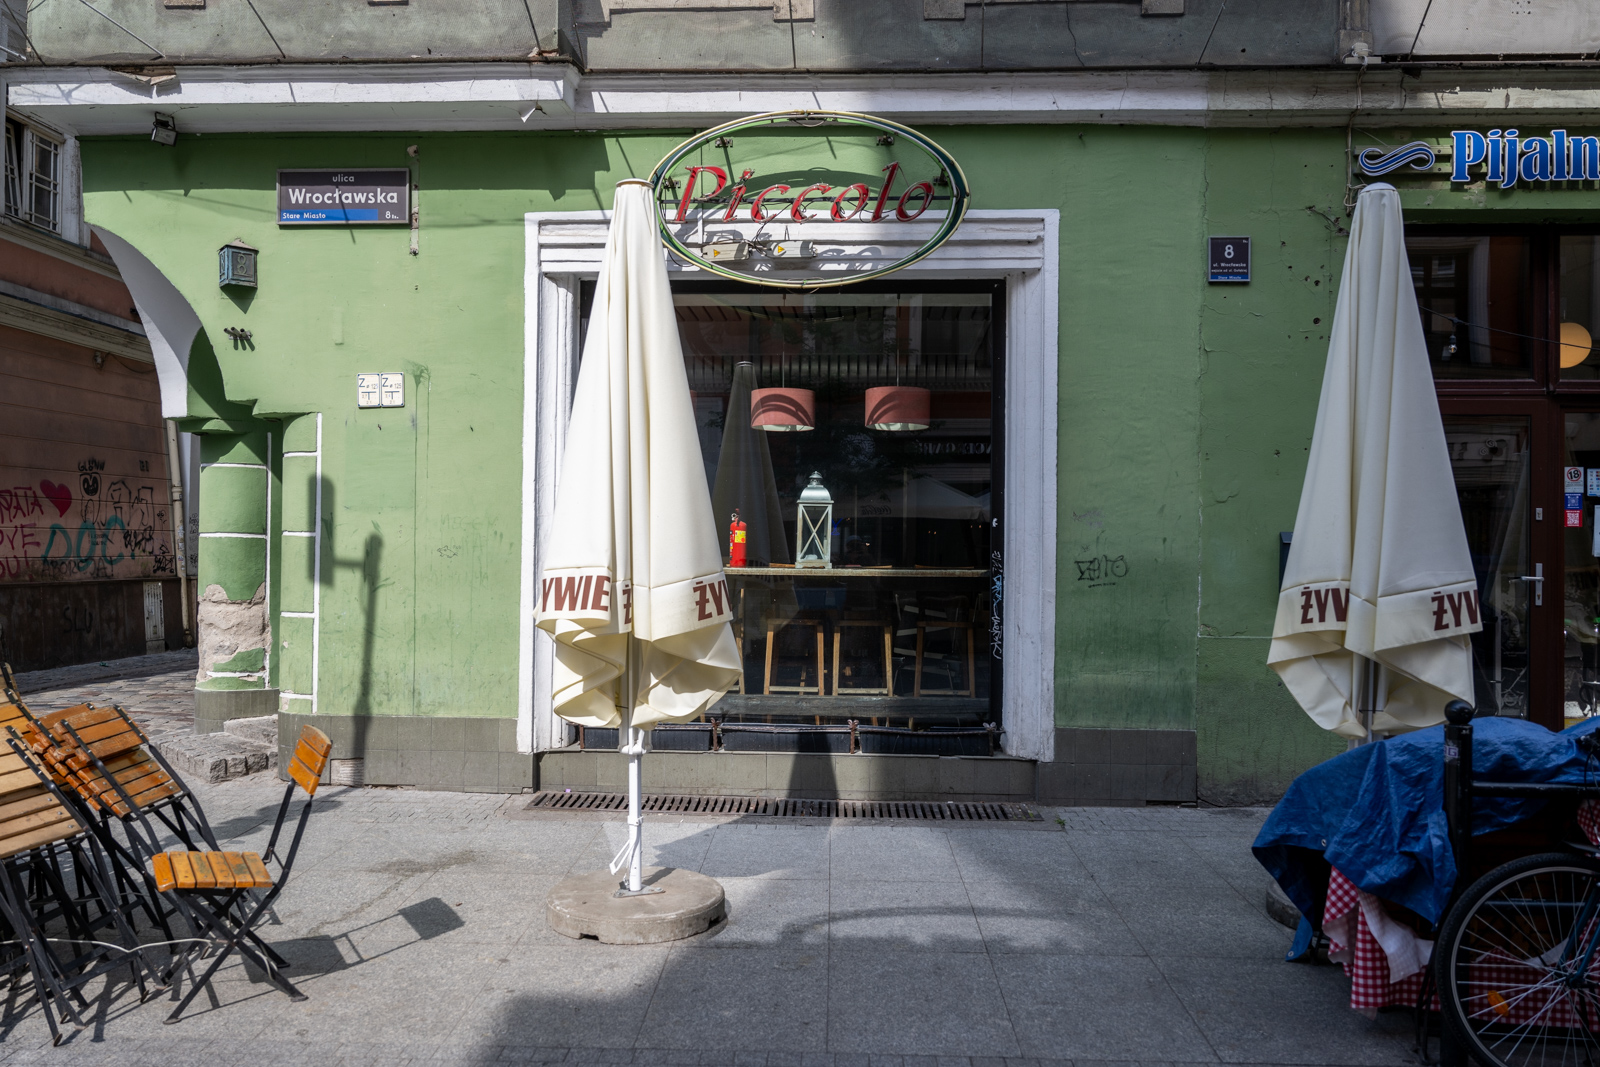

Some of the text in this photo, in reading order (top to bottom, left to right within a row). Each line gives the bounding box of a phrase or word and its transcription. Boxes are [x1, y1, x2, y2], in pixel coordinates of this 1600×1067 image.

[332, 173, 355, 183] ulica
[288, 187, 398, 204] Wrocławska
[673, 161, 935, 224] Piccolo
[385, 210, 391, 219] 8
[1224, 244, 1234, 258] 8
[359, 378, 365, 387] Z
[382, 378, 388, 387] Z
[1568, 469, 1580, 480] 18
